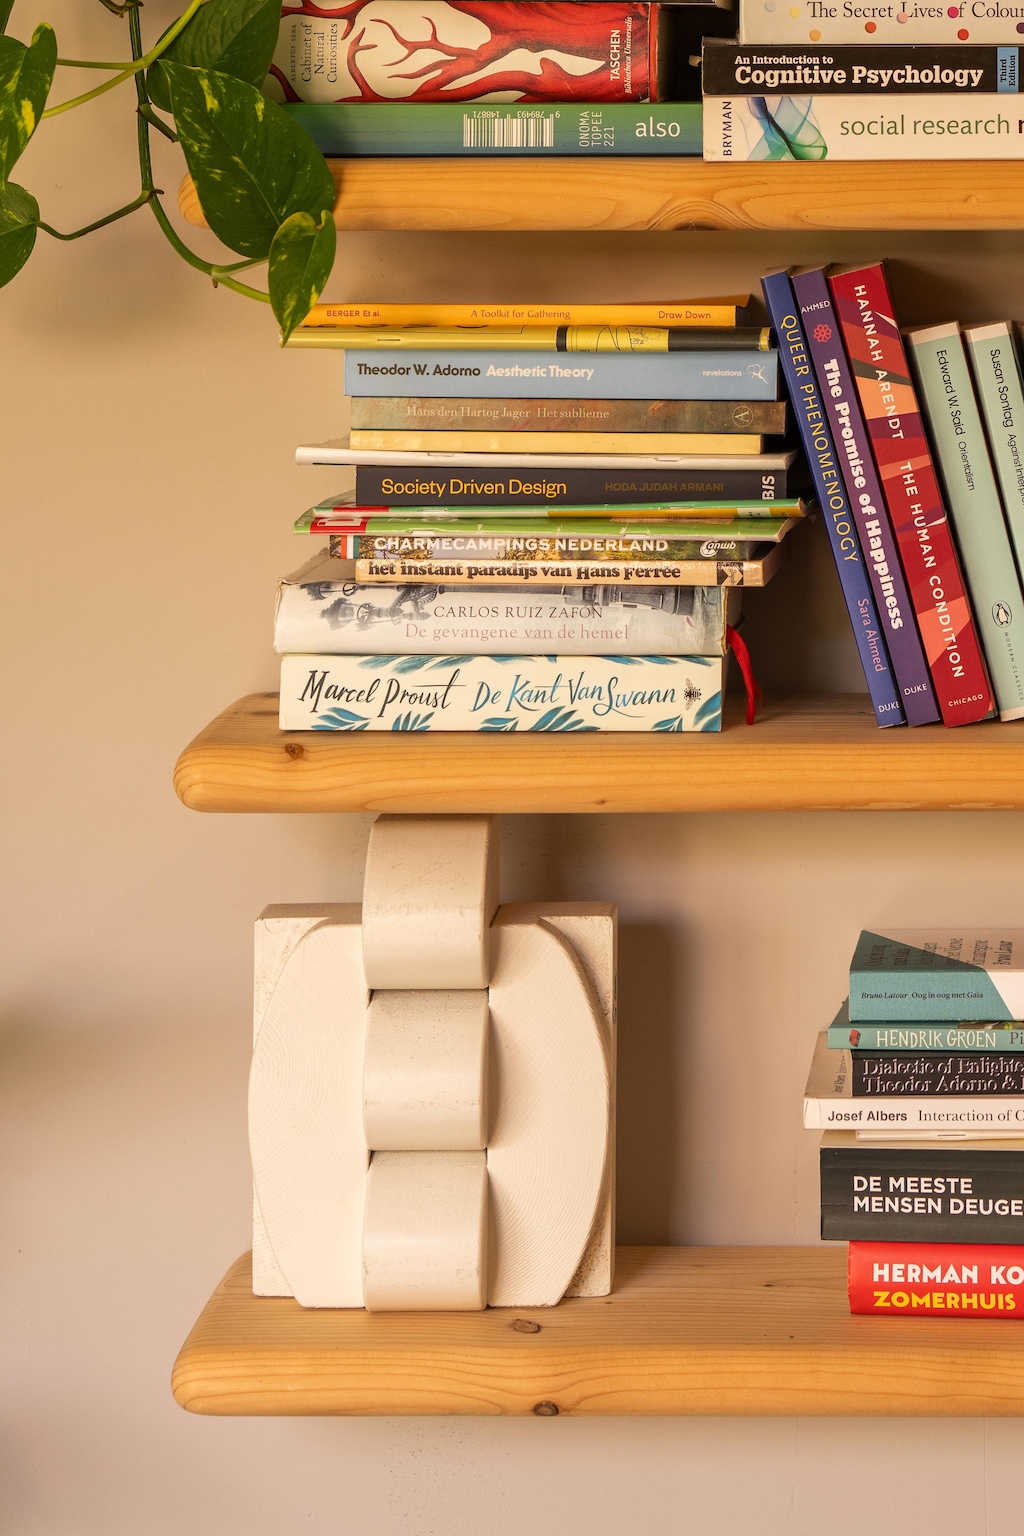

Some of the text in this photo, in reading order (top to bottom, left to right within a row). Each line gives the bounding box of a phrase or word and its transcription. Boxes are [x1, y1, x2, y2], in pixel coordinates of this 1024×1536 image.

[610, 29, 620, 81] TASCHEN
[735, 65, 983, 88] Cognitive Psychology
[635, 117, 680, 137] also
[840, 114, 905, 136] social
[912, 115, 1010, 135] research
[357, 364, 594, 381] Theodor W. Adorno Aesthetic Theory
[781, 315, 857, 562] QUEER PHENOMENOLOGY
[381, 479, 567, 501] Society Driven Design
[854, 285, 964, 677] HANNAH ARENDT THE HUMAN CONDITION
[298, 669, 466, 713] Marcel Proust
[877, 1031, 942, 1048] HENDRIK
[947, 1030, 996, 1048] GROEN
[828, 1110, 861, 1121] Josef
[865, 1111, 907, 1122] Albers
[918, 1110, 995, 1122] Interaction
[999, 1109, 1012, 1121] of
[853, 1176, 972, 1194] DE MEESTE
[853, 1197, 943, 1214] MENSEN
[872, 1263, 978, 1284] HERMAN
[873, 1291, 1015, 1310] ZOMERHUIS
